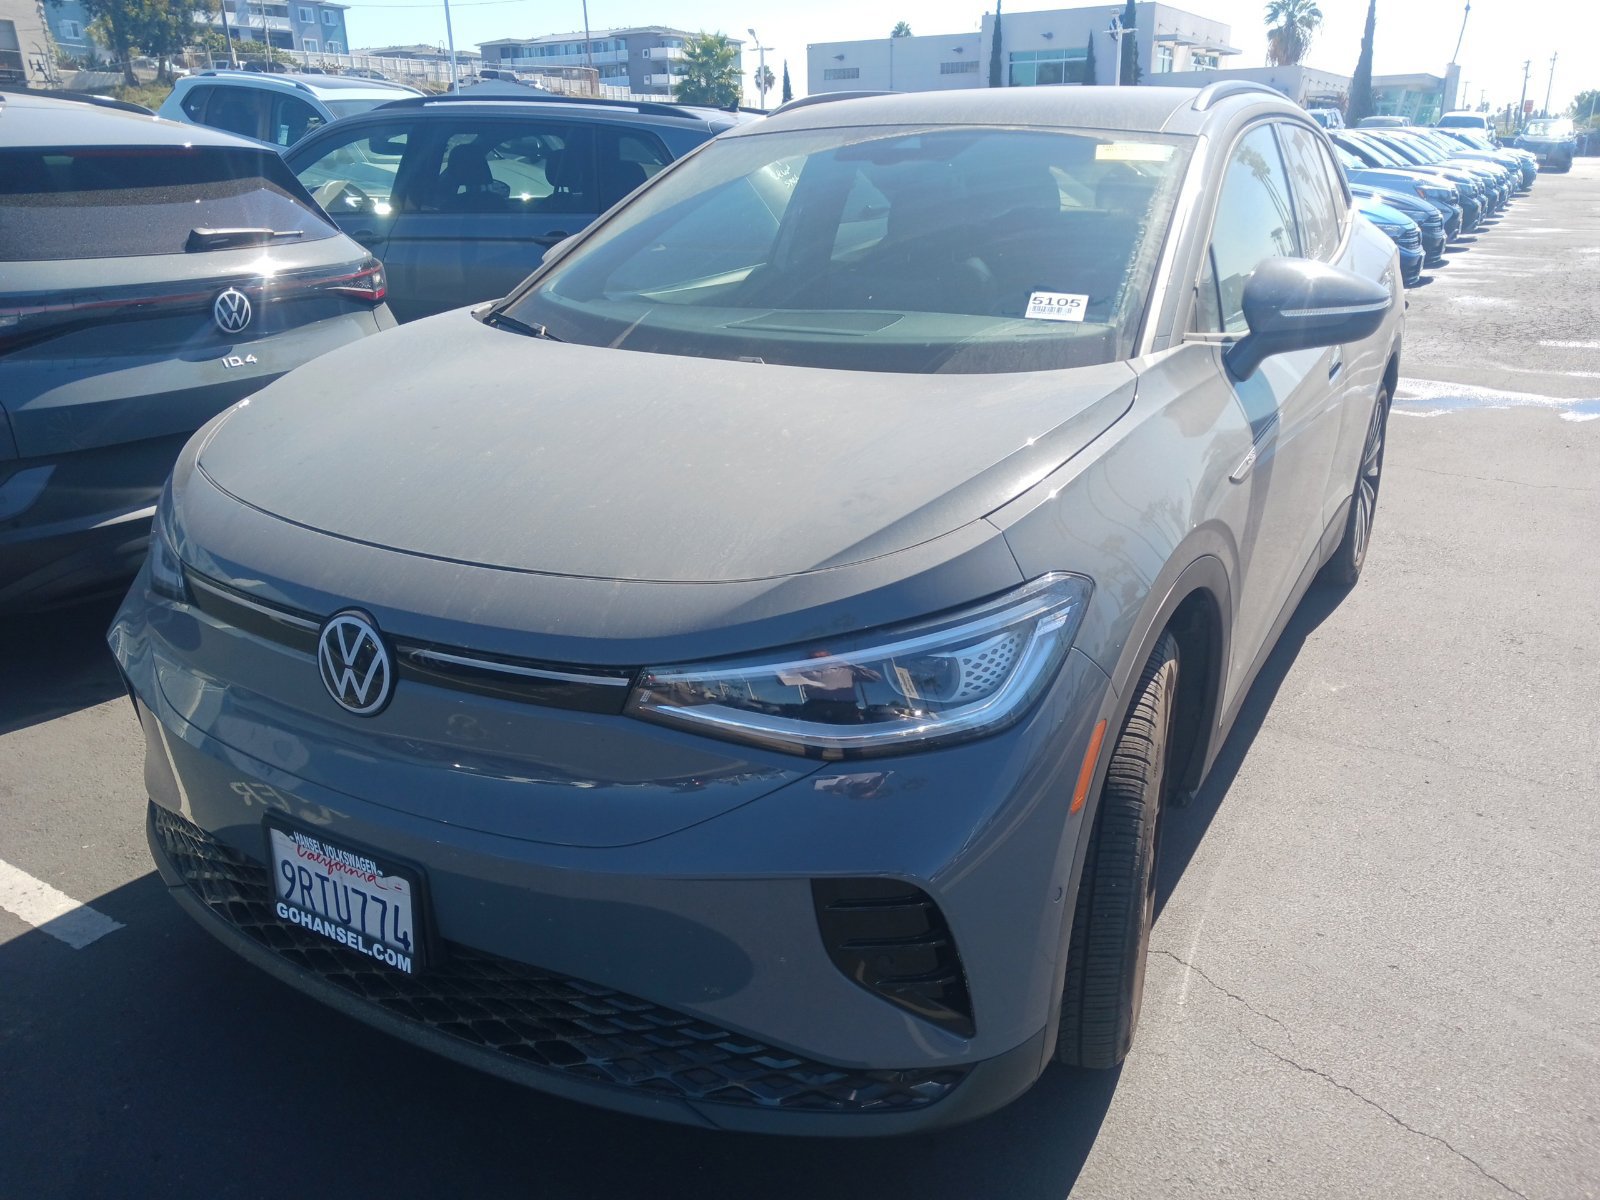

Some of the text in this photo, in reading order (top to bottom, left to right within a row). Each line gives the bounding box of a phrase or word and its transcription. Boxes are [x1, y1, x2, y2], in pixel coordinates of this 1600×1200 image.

[1032, 296, 1082, 308] 5105
[319, 617, 388, 709] VW
[293, 831, 377, 875] HANSEL VOLKSWAGEN
[276, 902, 412, 974] GOHANSEL.COM
[281, 859, 411, 951] 9RTU774
